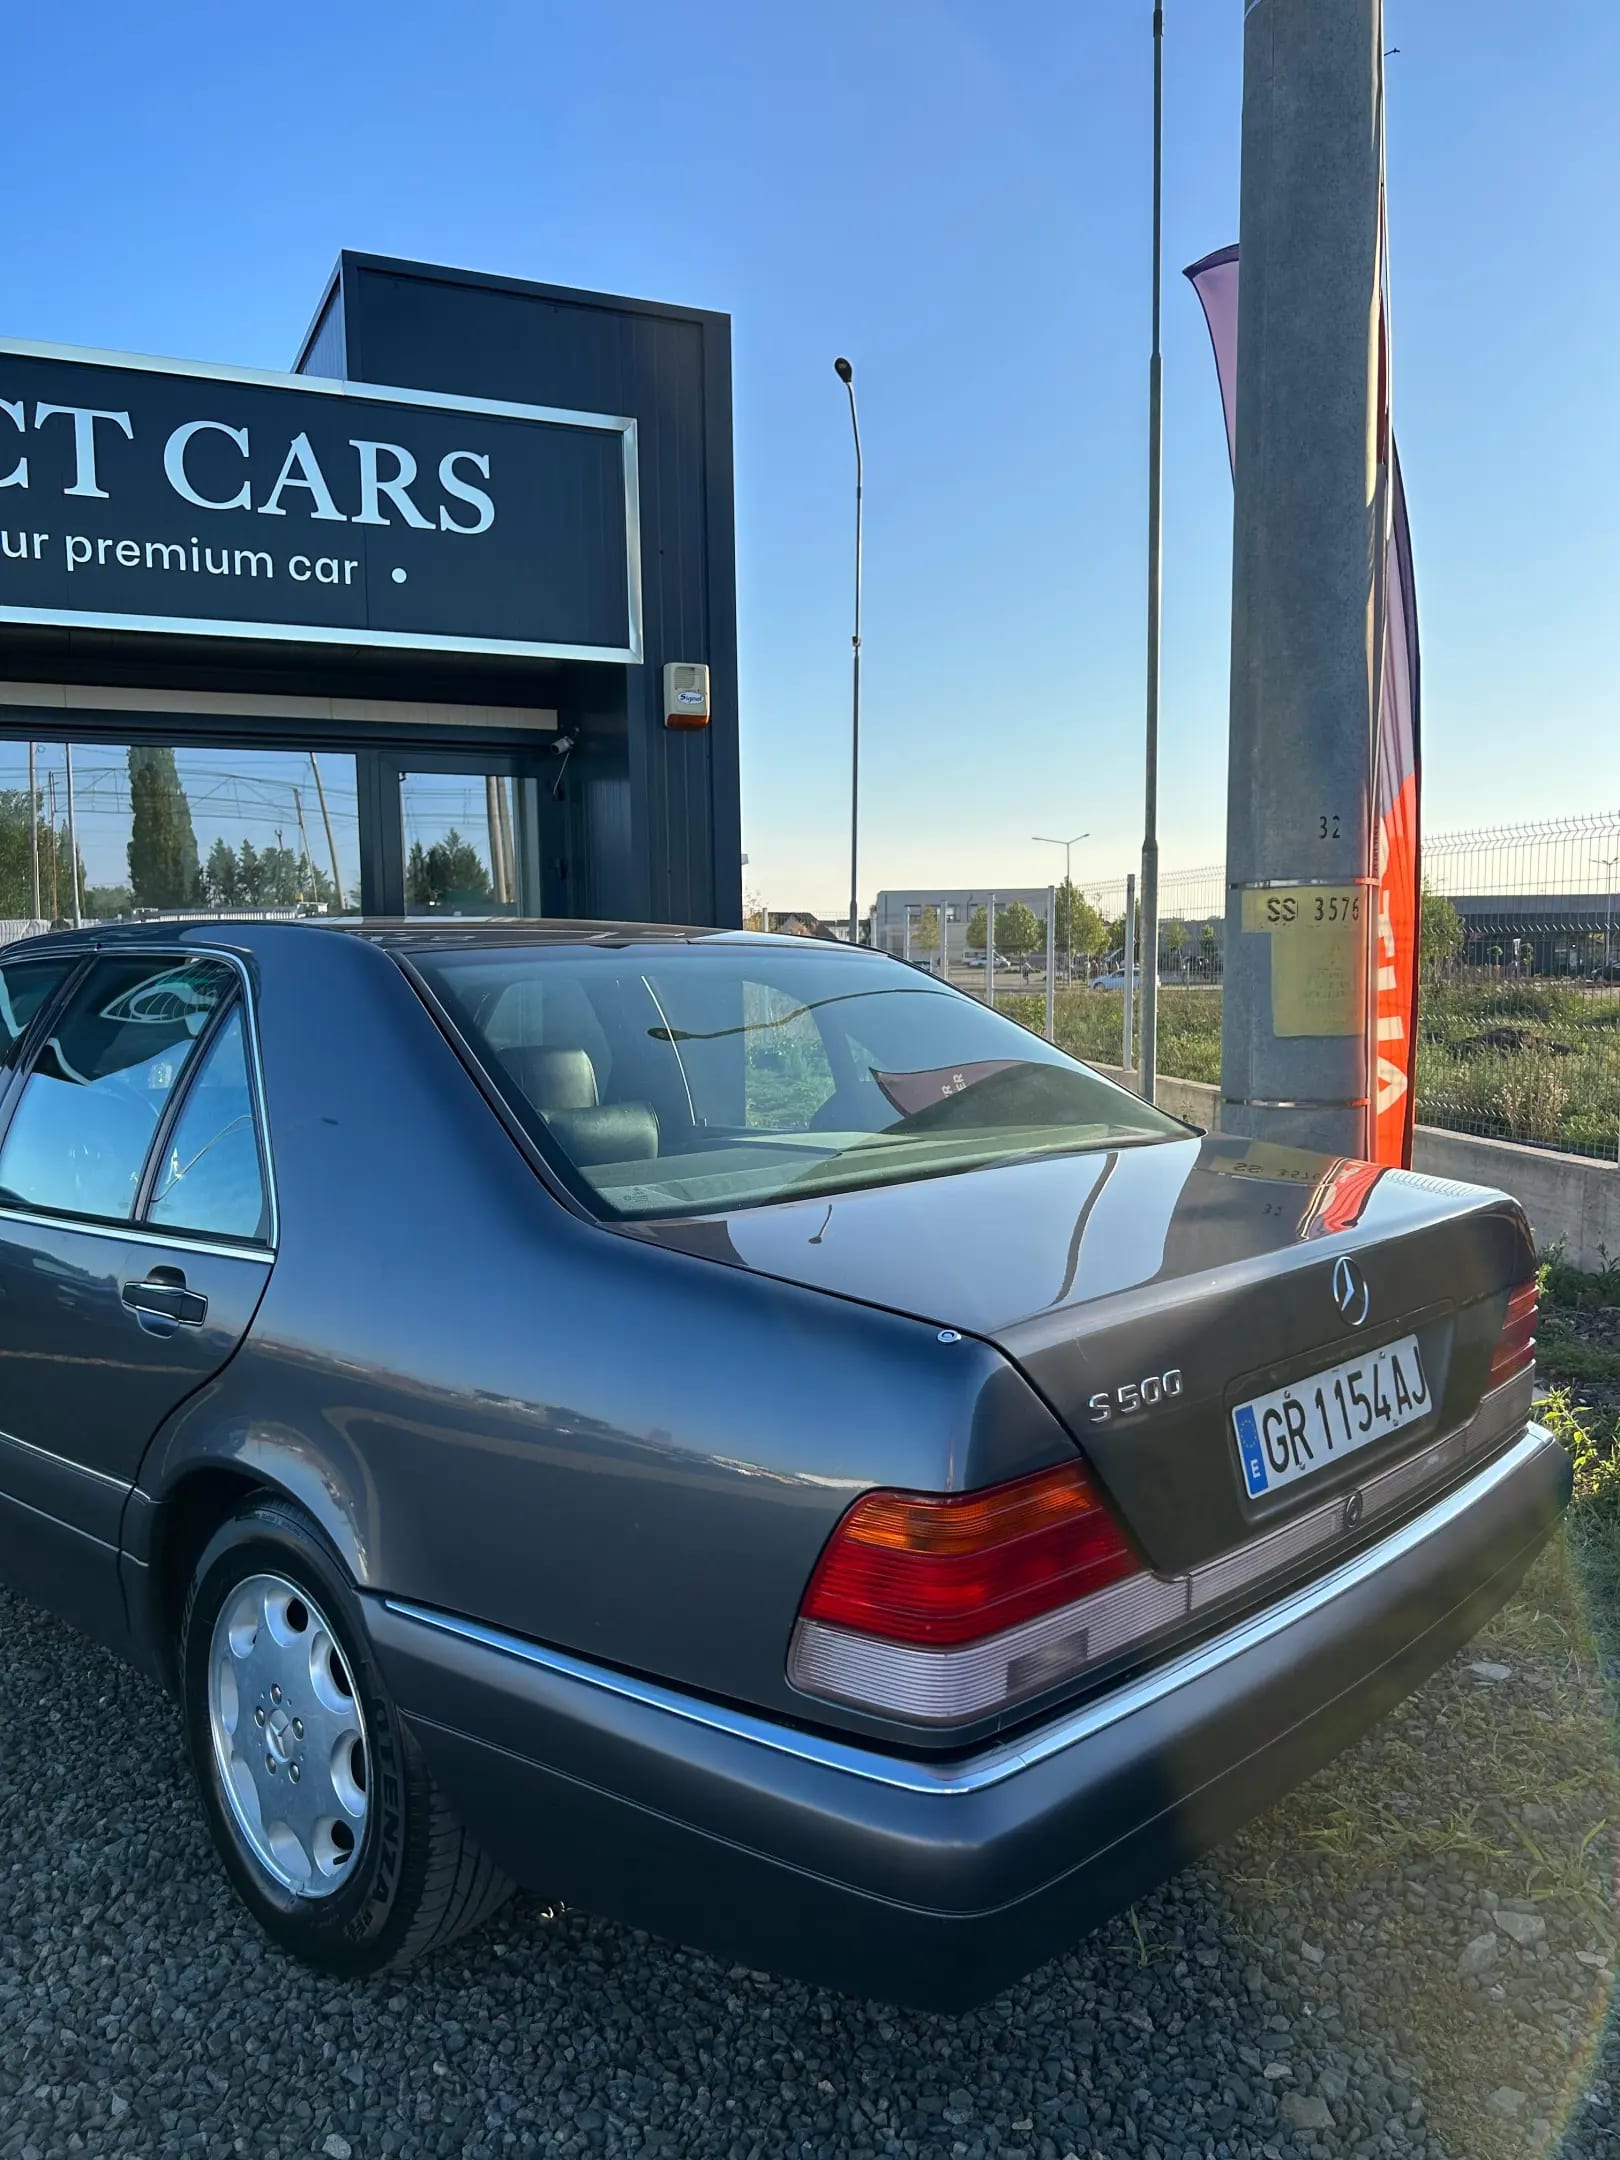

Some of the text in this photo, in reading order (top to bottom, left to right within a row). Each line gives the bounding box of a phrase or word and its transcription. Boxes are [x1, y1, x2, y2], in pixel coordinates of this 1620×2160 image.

[163, 420, 496, 535] CARS
[0, 530, 359, 585] ur premium car
[1319, 815, 1341, 840] 32
[1266, 896, 1360, 922] SS 3576
[1089, 1369, 1184, 1423] S 500
[1250, 1459, 1261, 1479] E
